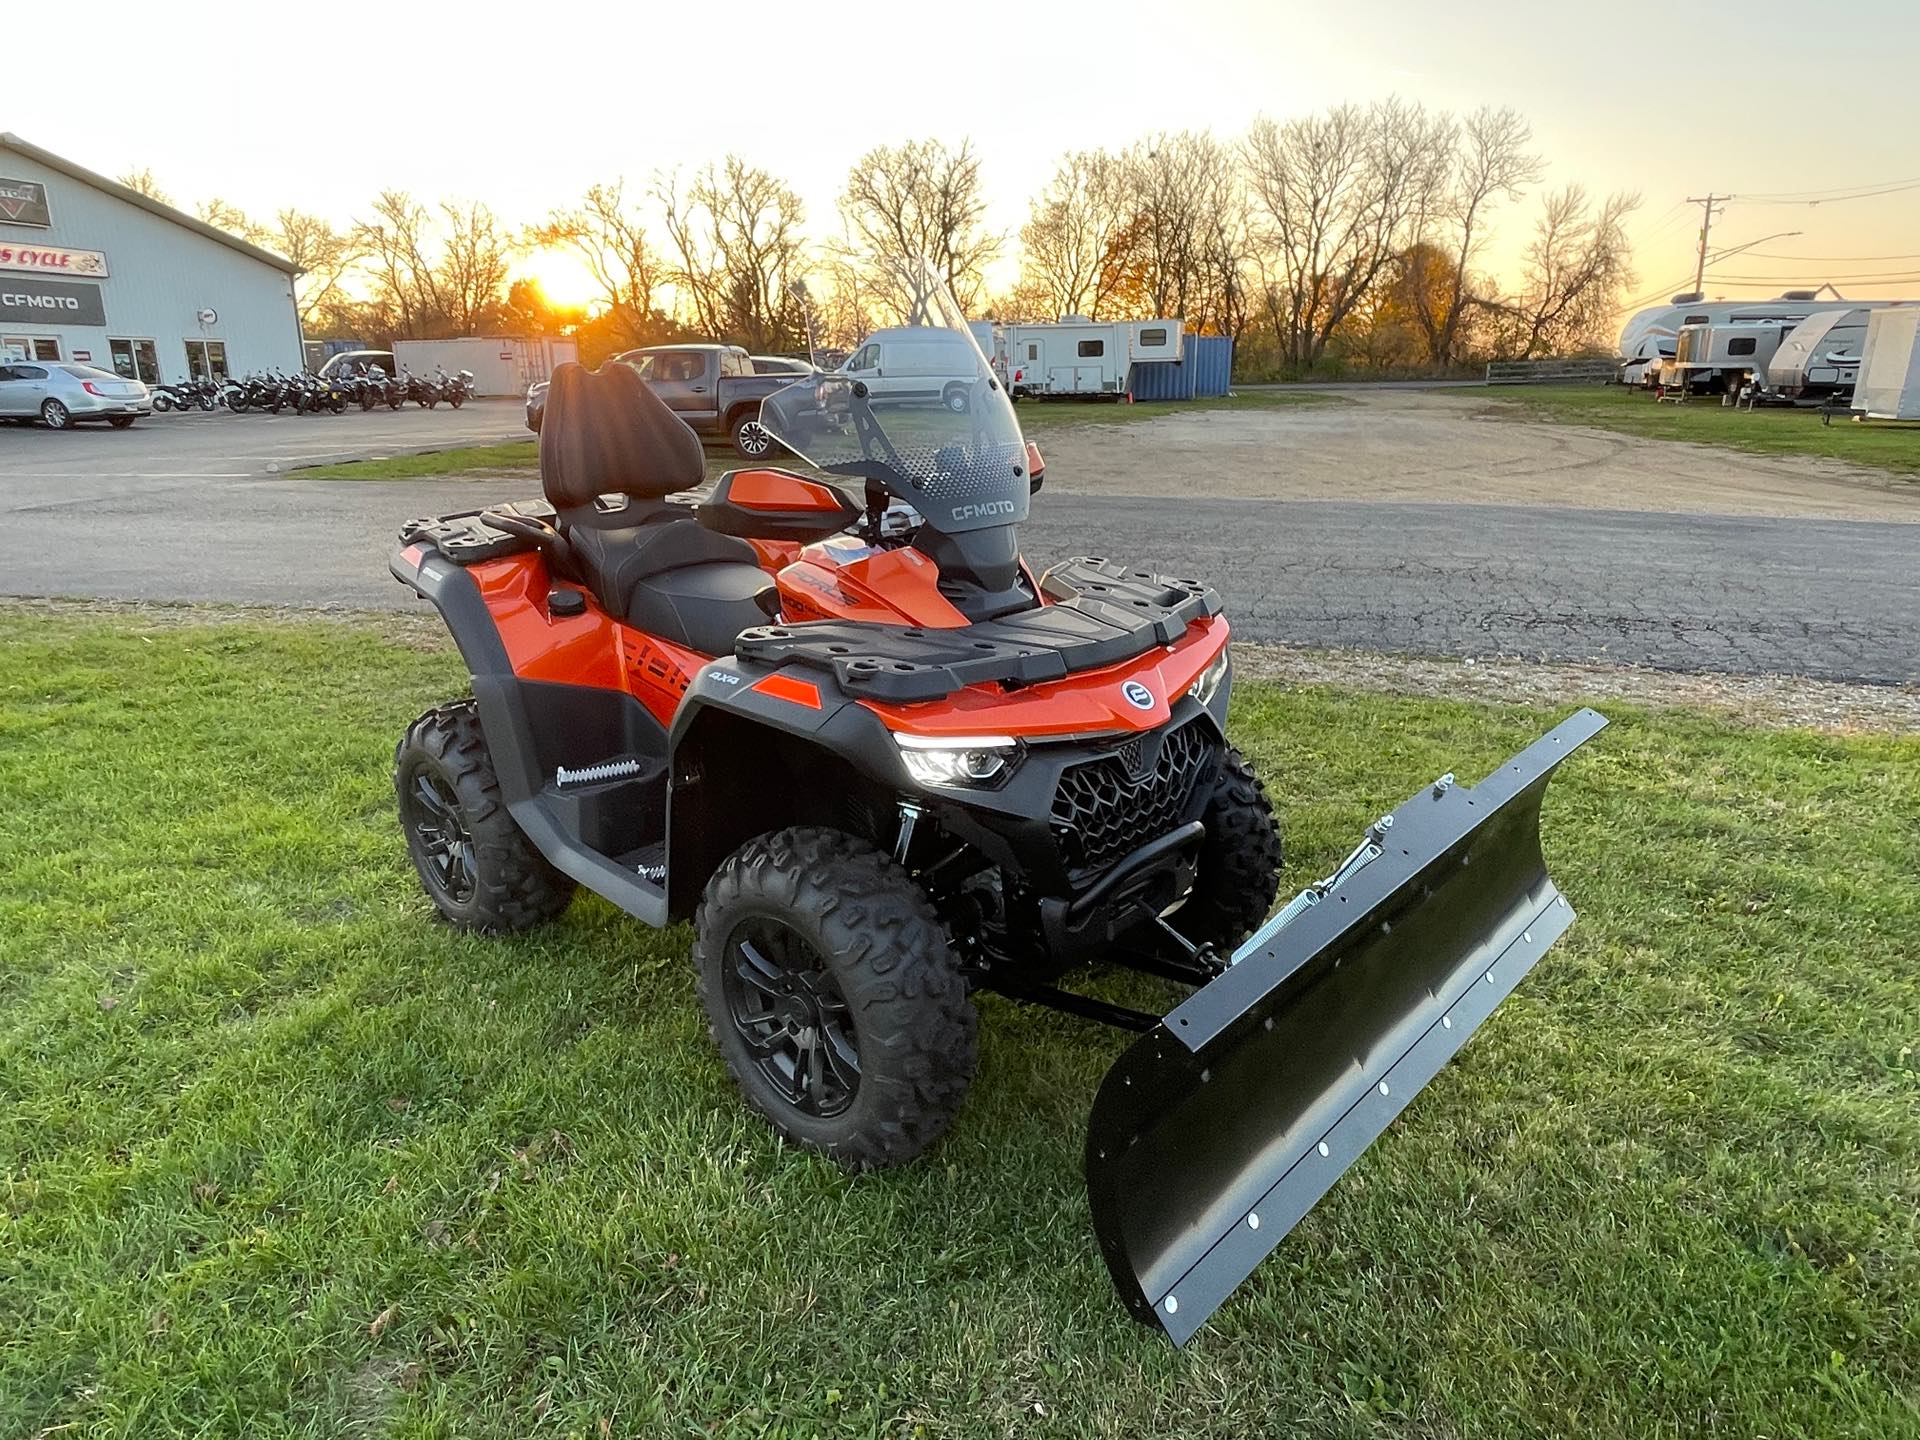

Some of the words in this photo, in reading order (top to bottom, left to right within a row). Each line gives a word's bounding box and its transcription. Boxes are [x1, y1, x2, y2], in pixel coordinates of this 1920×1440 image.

[0, 249, 12, 264] S
[18, 250, 71, 268] CYCLE
[2, 293, 79, 310] CFMOTO
[951, 500, 1014, 521] CFMOTO
